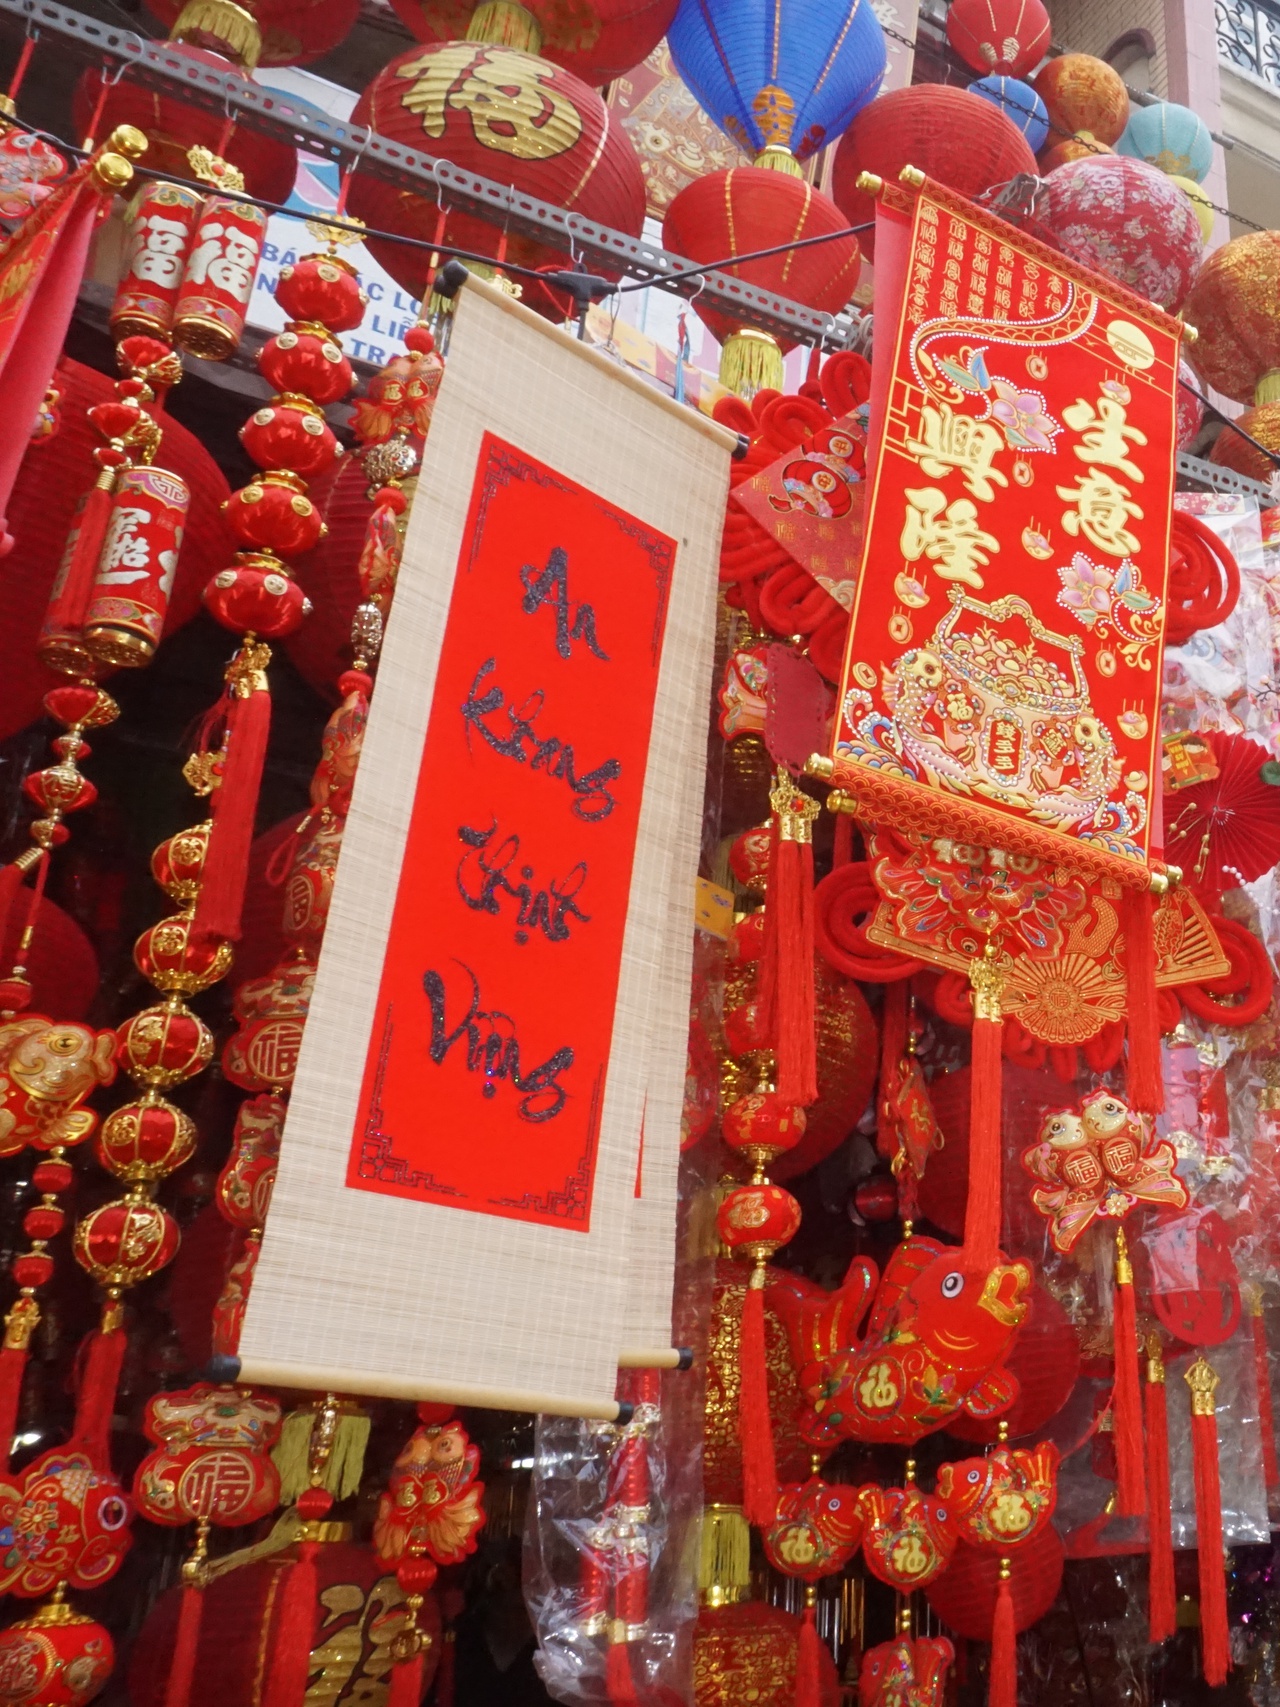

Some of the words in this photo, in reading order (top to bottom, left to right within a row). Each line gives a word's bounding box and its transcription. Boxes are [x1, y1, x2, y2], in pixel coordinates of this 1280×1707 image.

[131, 214, 190, 290] 福
[185, 222, 260, 304] 福
[900, 401, 1009, 590] 興隆
[1056, 397, 1148, 558] 生意
[518, 546, 611, 661] An
[460, 657, 623, 822] Khang
[947, 692, 974, 721] 福
[456, 812, 593, 945] Thịnh
[423, 957, 576, 1124] Vượng
[1065, 1155, 1100, 1186] 福
[1105, 1142, 1136, 1174] 福
[858, 1361, 898, 1409] 福
[181, 1451, 256, 1517] 福
[990, 1493, 1031, 1534] 福
[780, 1525, 816, 1566] 福
[892, 1535, 927, 1574] 福
